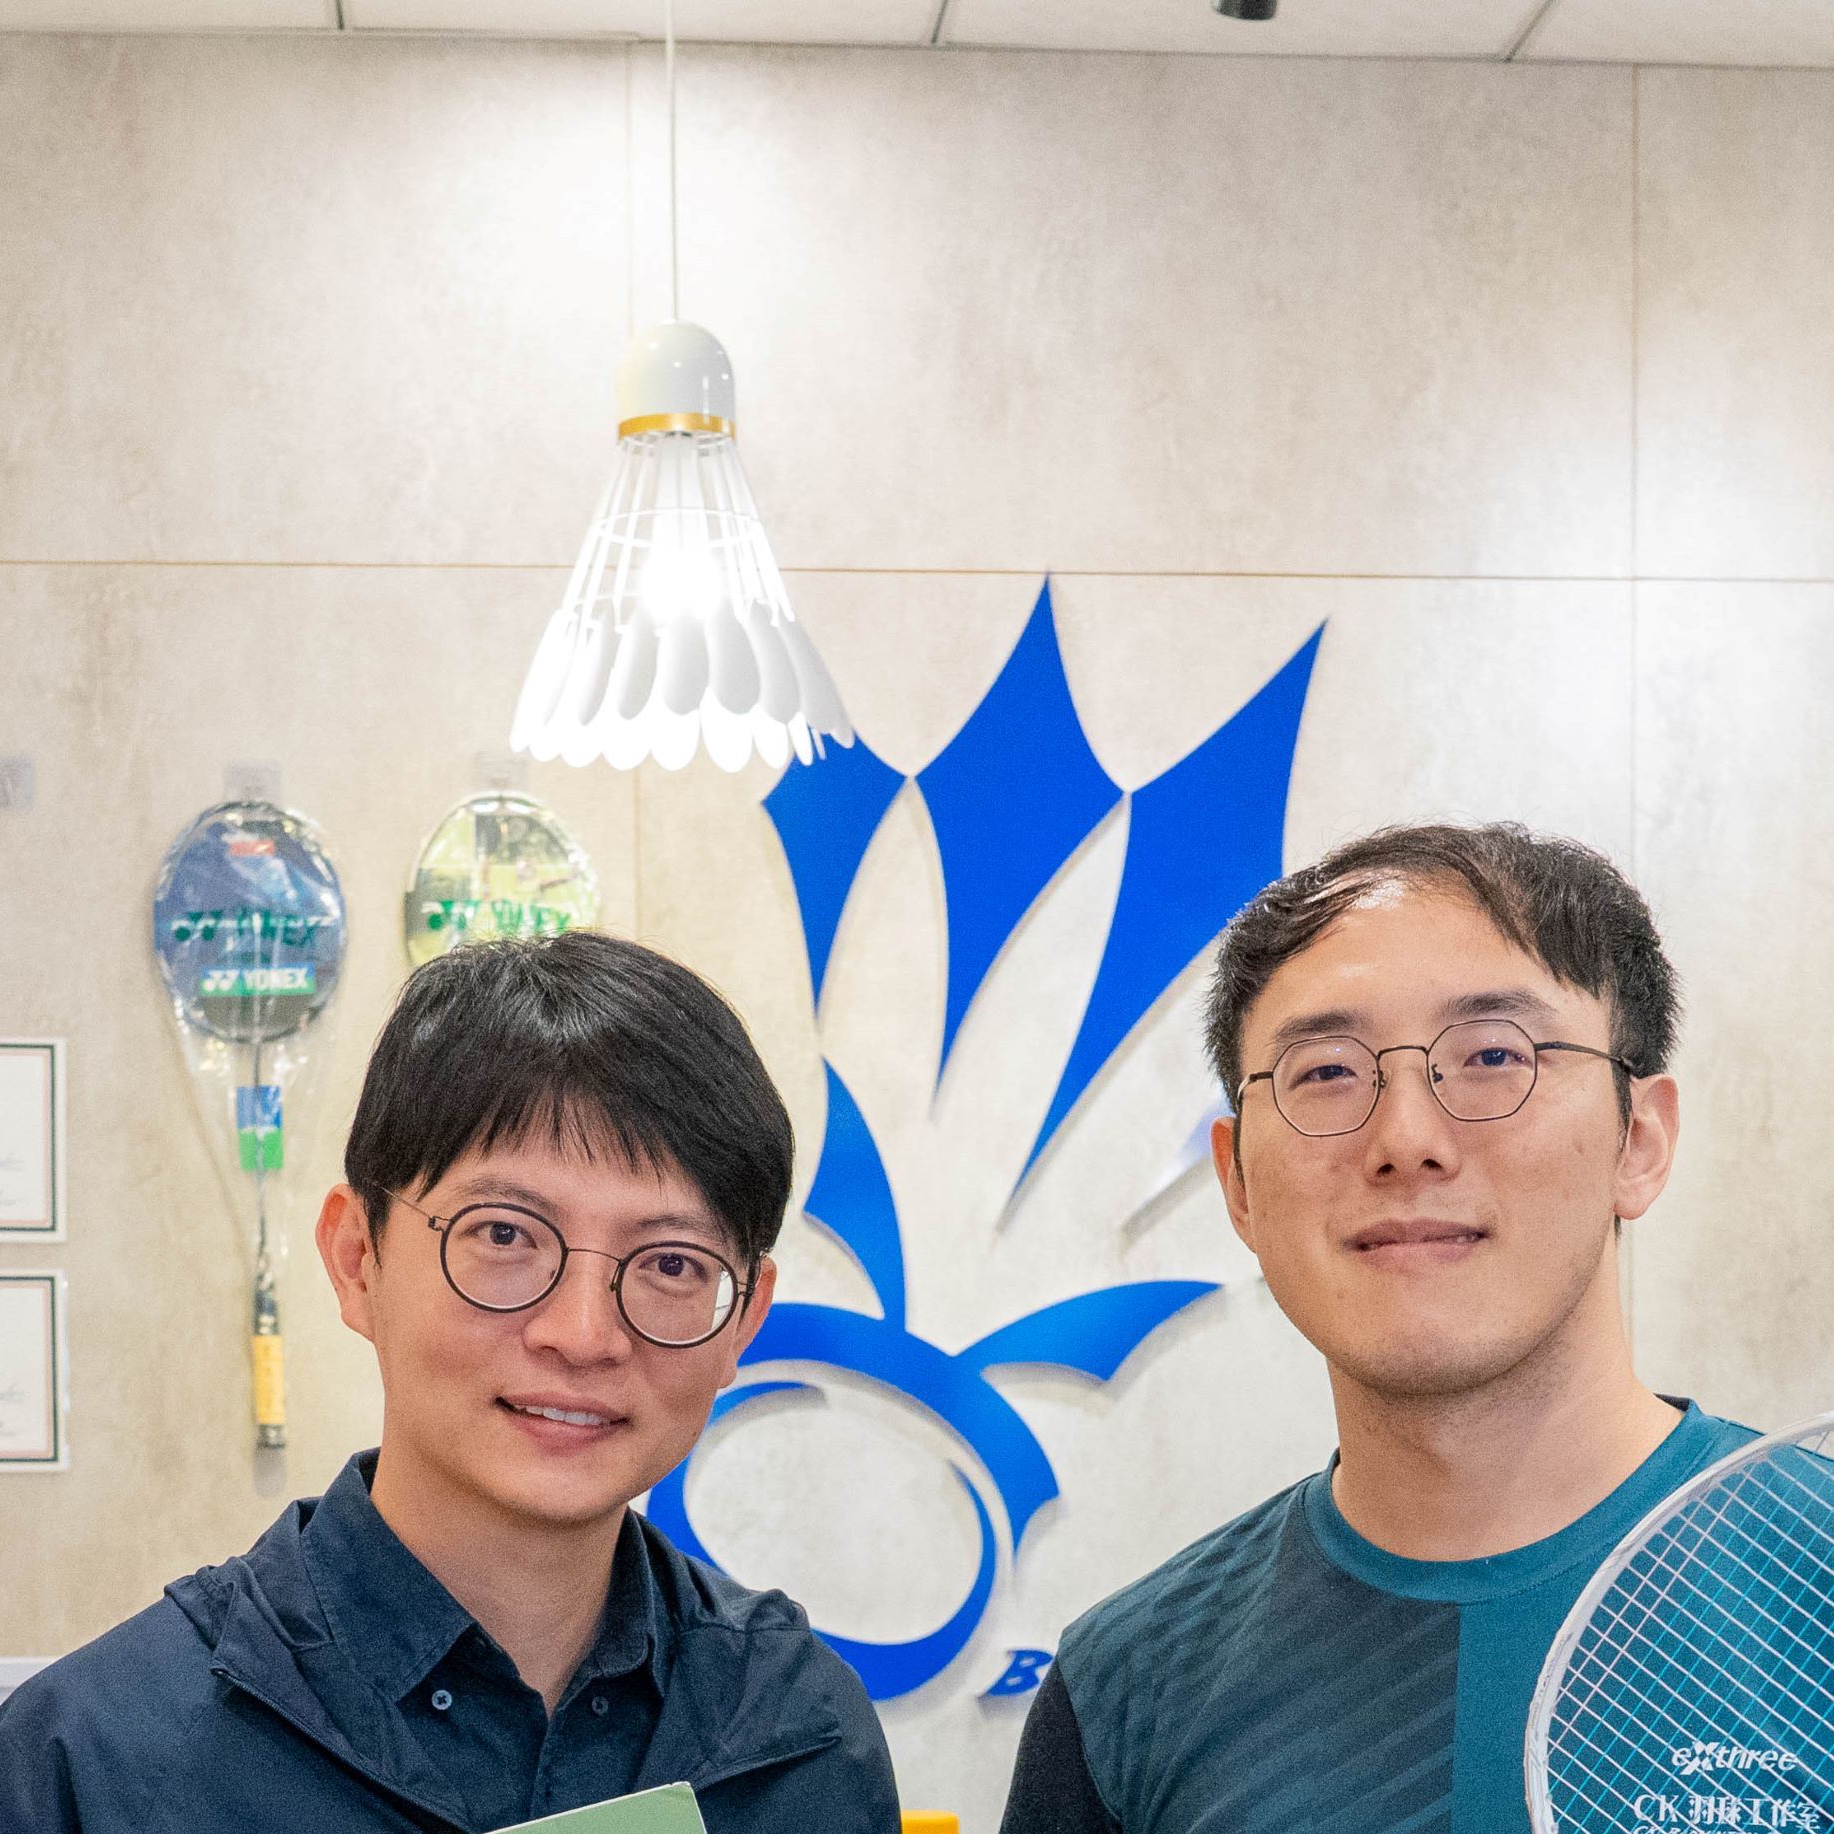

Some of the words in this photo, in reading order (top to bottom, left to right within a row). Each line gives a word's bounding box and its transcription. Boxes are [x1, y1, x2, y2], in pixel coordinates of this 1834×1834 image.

[1633, 1793, 1680, 1823] CK
[1688, 1794, 1822, 1830] 羽球工作室
